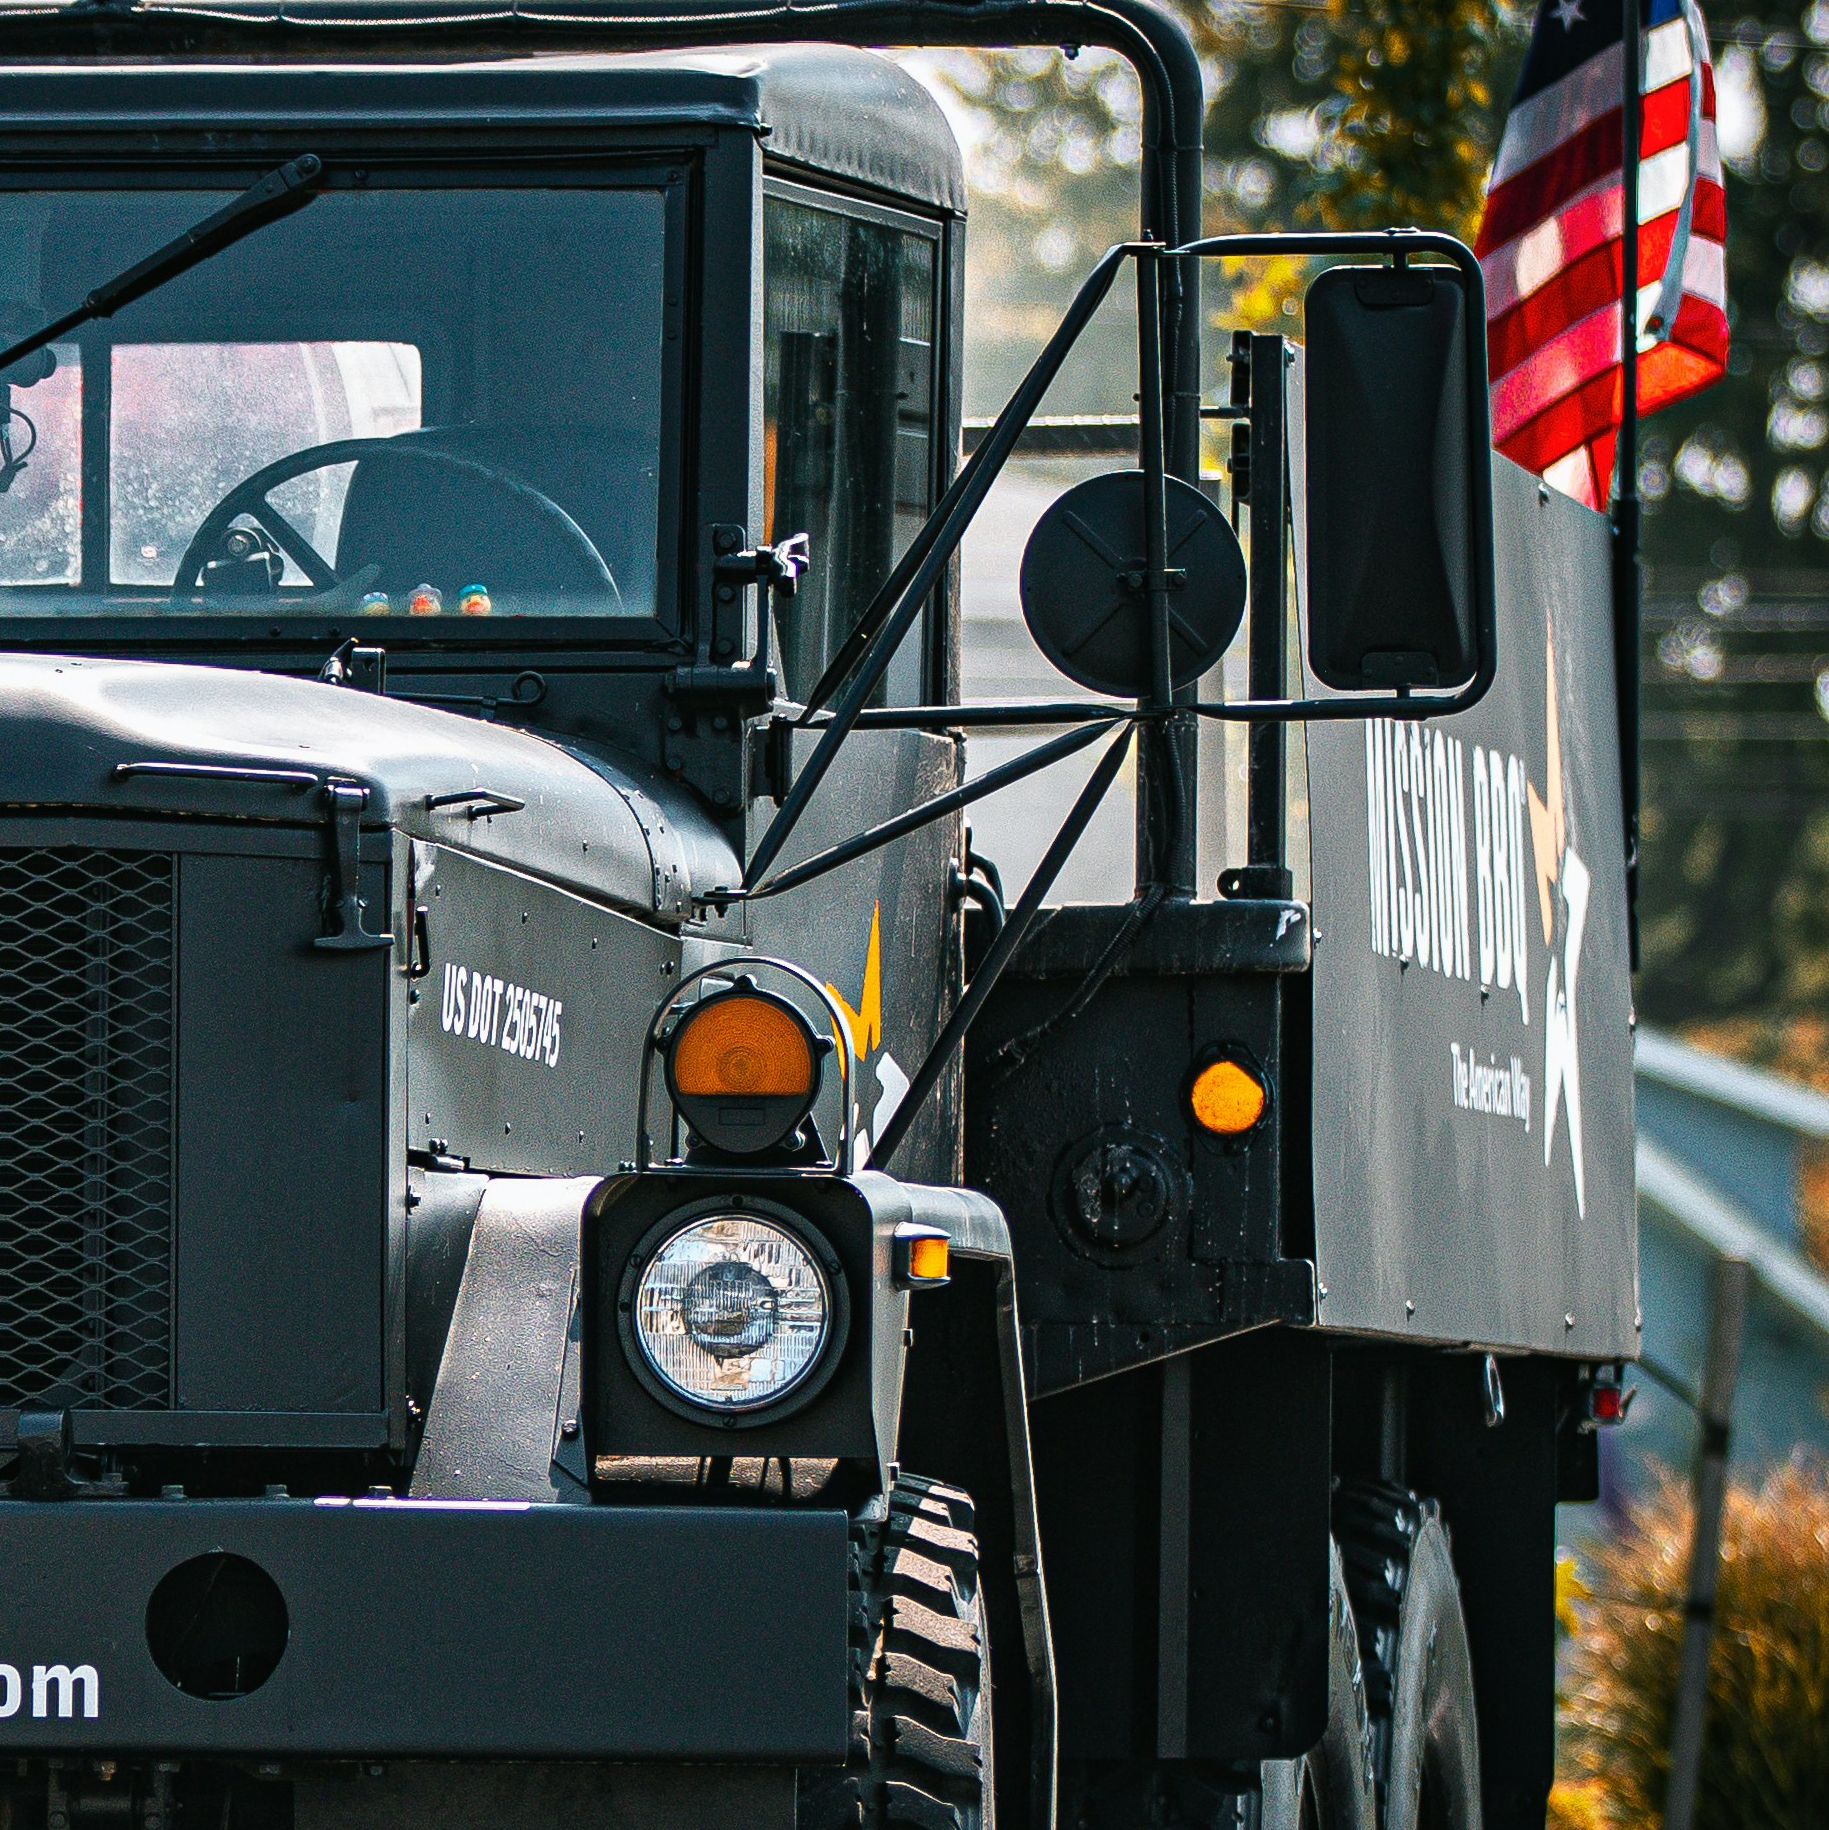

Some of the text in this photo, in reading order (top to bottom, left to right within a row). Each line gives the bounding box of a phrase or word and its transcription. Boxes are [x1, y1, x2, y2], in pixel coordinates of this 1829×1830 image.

[1364, 717, 1531, 1026] MISSION BBQ
[442, 962, 563, 1069] US DOT 2505745
[1450, 1041, 1531, 1134] The American Way
